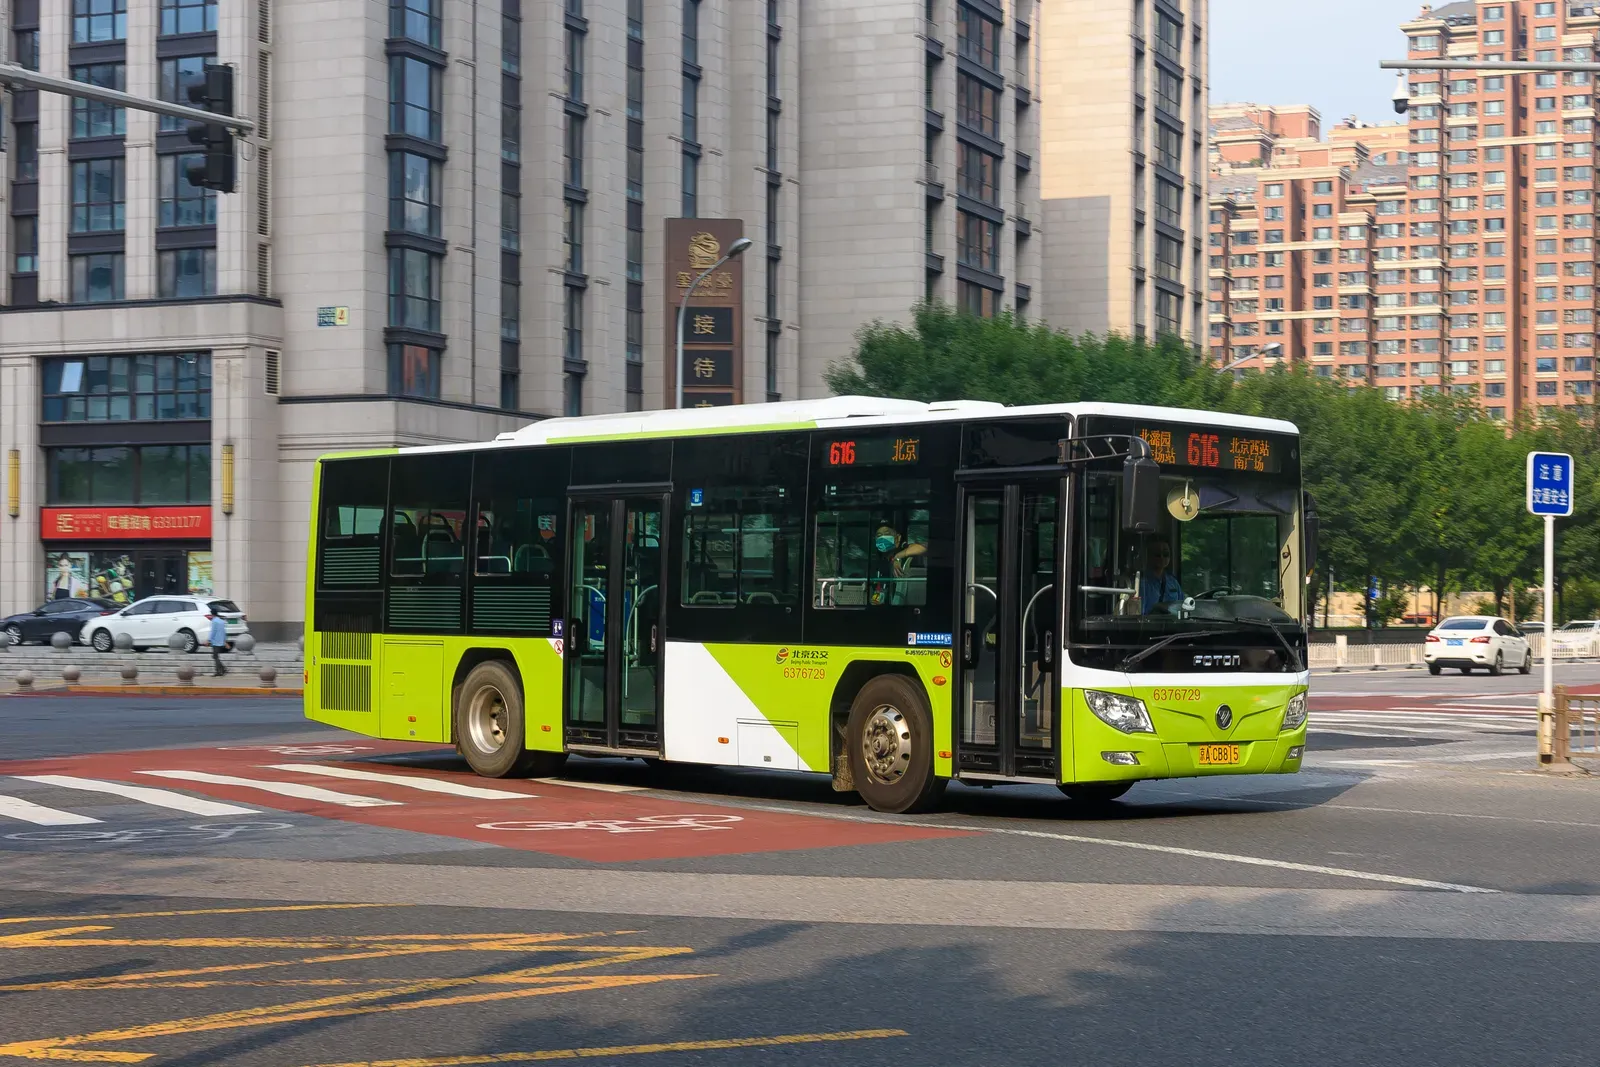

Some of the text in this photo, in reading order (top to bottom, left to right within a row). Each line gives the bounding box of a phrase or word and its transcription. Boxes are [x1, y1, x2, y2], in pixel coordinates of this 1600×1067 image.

[829, 439, 919, 465] 616 北京
[1187, 432, 1220, 467] 616
[1229, 437, 1270, 457] 北京西站
[1233, 455, 1265, 472] 南广场
[791, 650, 828, 660] 北京公交
[1193, 655, 1241, 667] FOTON
[783, 668, 826, 680] 6376729
[1153, 688, 1201, 701] 6376729
